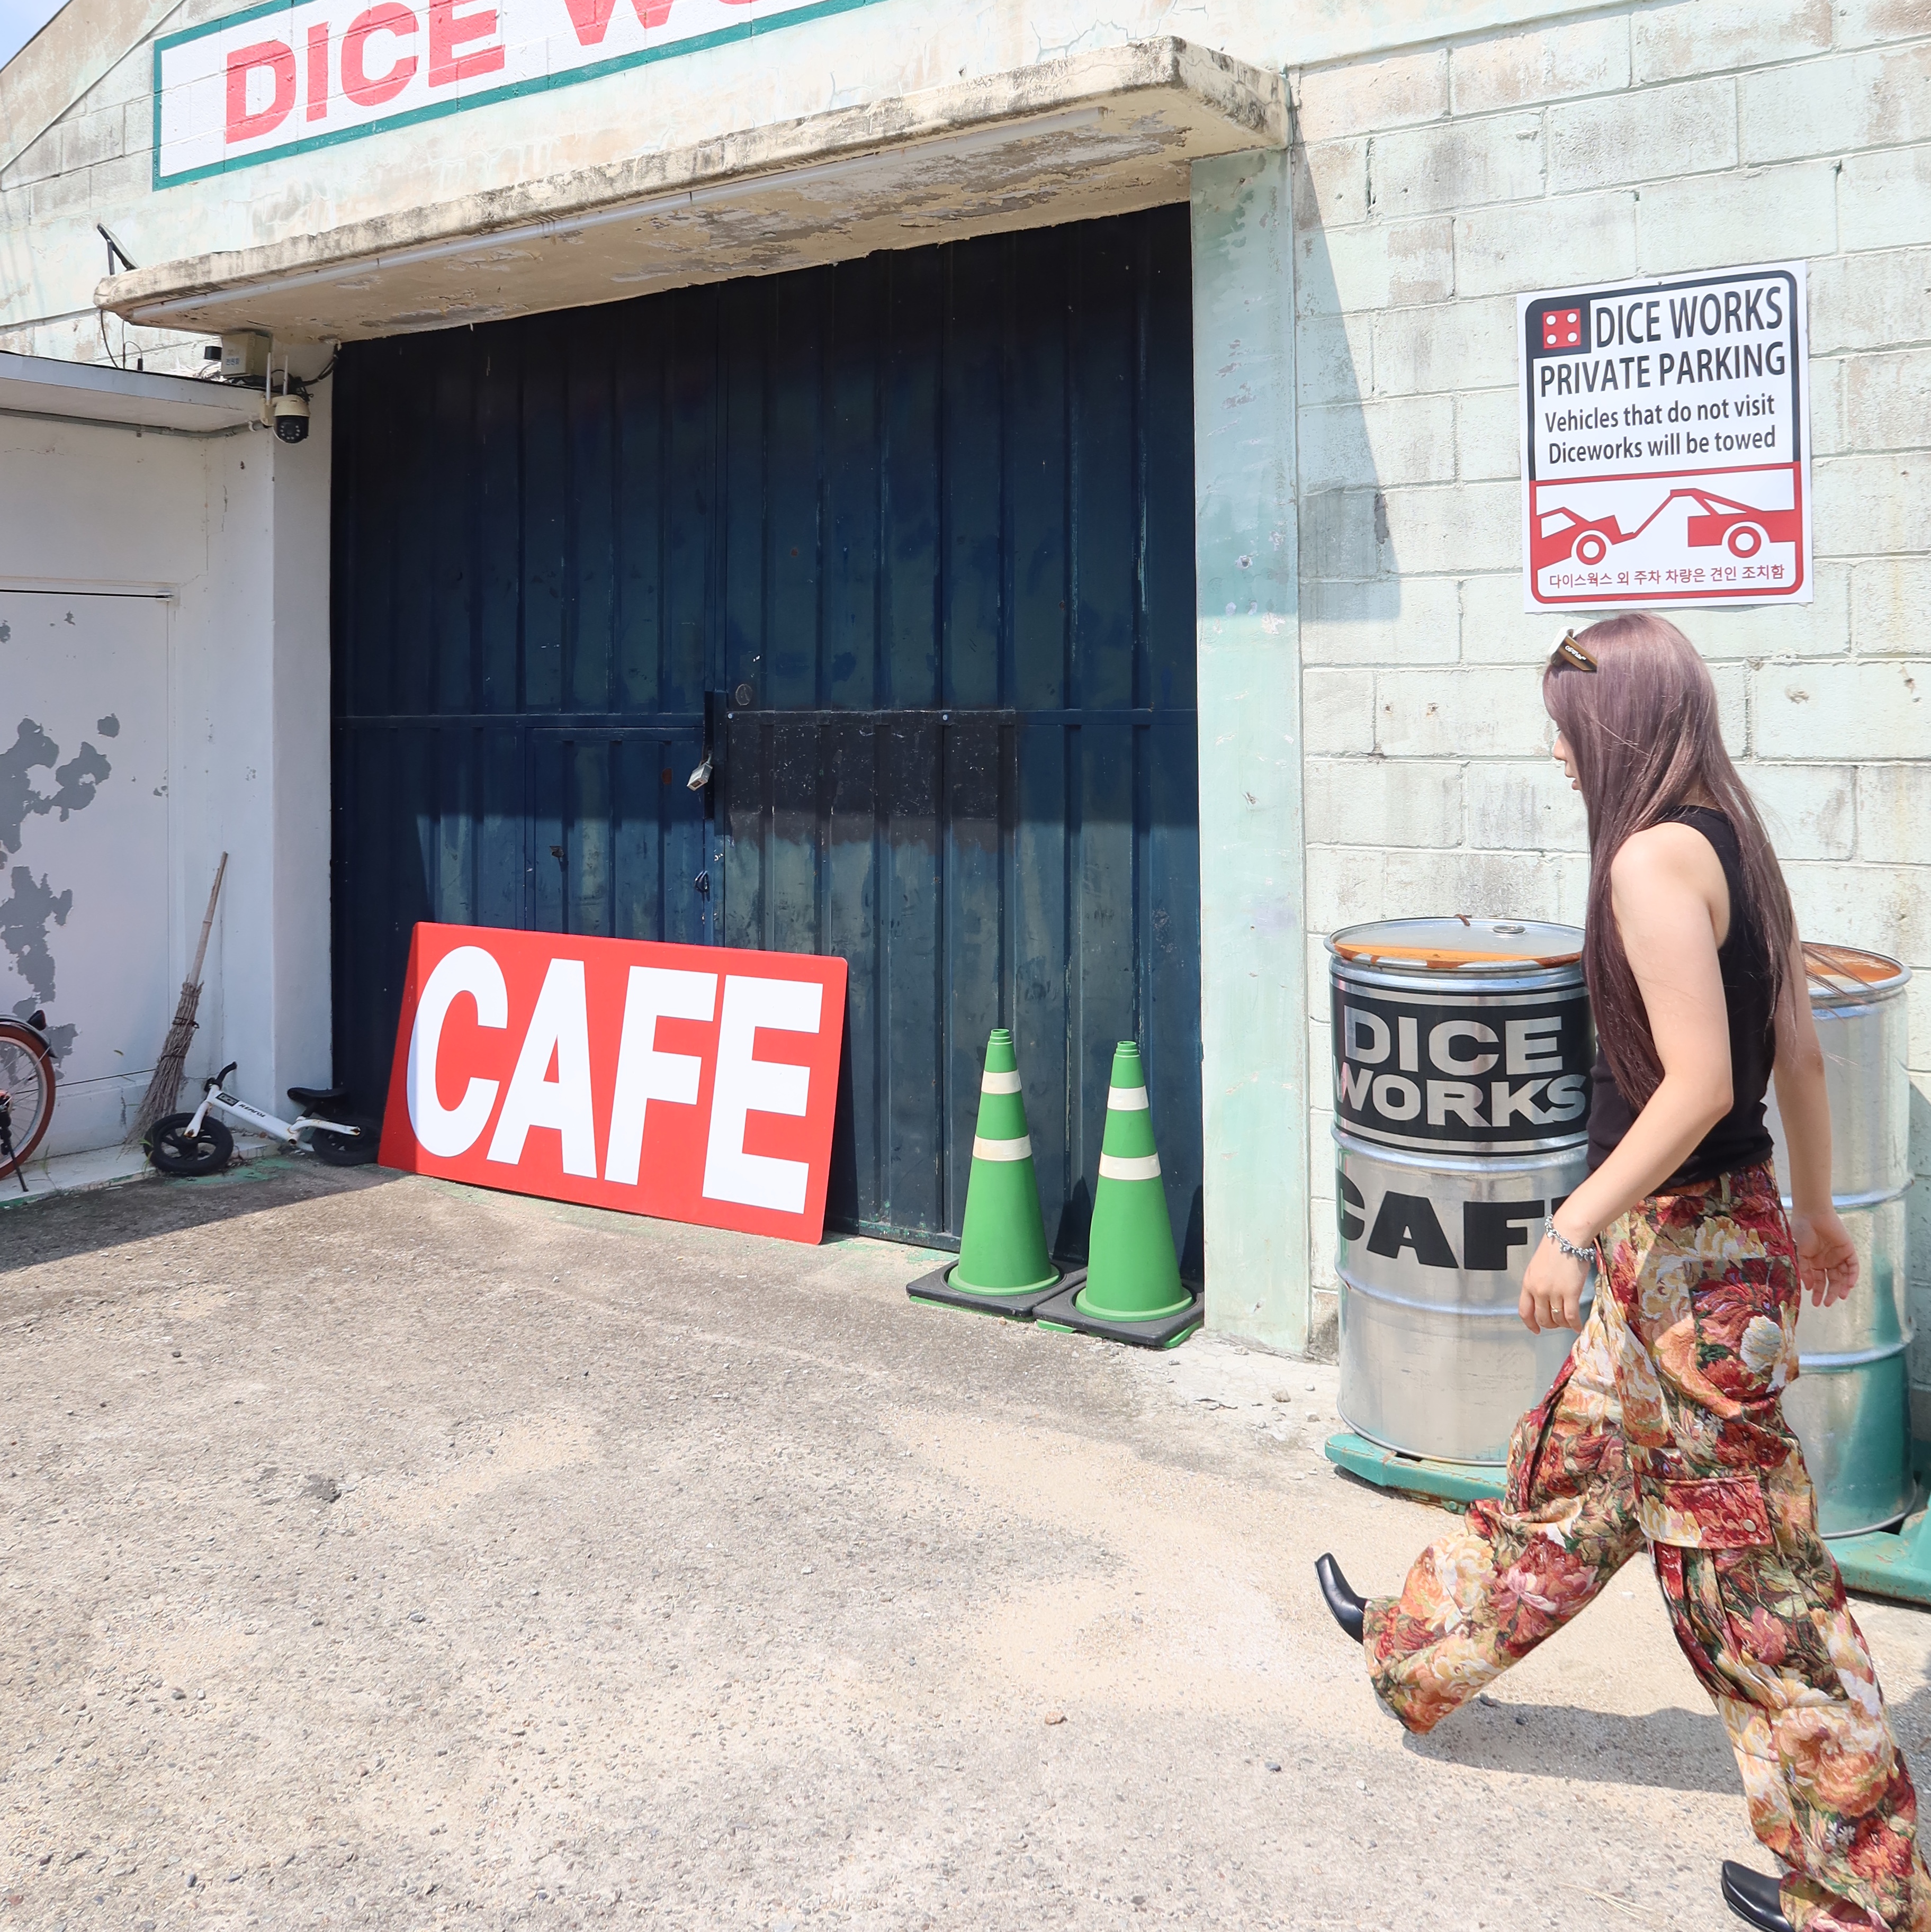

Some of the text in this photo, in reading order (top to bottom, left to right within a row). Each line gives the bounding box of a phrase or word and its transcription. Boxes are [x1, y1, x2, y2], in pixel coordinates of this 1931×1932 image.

[226, 0, 506, 143] DICE
[1596, 286, 1783, 348] DICE WORKS
[1540, 341, 1785, 398] PRIVATE PARKING
[1544, 393, 1775, 433] Vehicles that do not visit
[1549, 424, 1775, 464] Diceworks will be towed
[1549, 564, 1785, 589] 다이스웍스 외 주차 차량은 견인 조치함
[1344, 1005, 1563, 1076] DICE
[406, 945, 823, 1214] CAFE
[1334, 1055, 1586, 1127] WORKS
[1336, 1167, 1570, 1270] CAF
